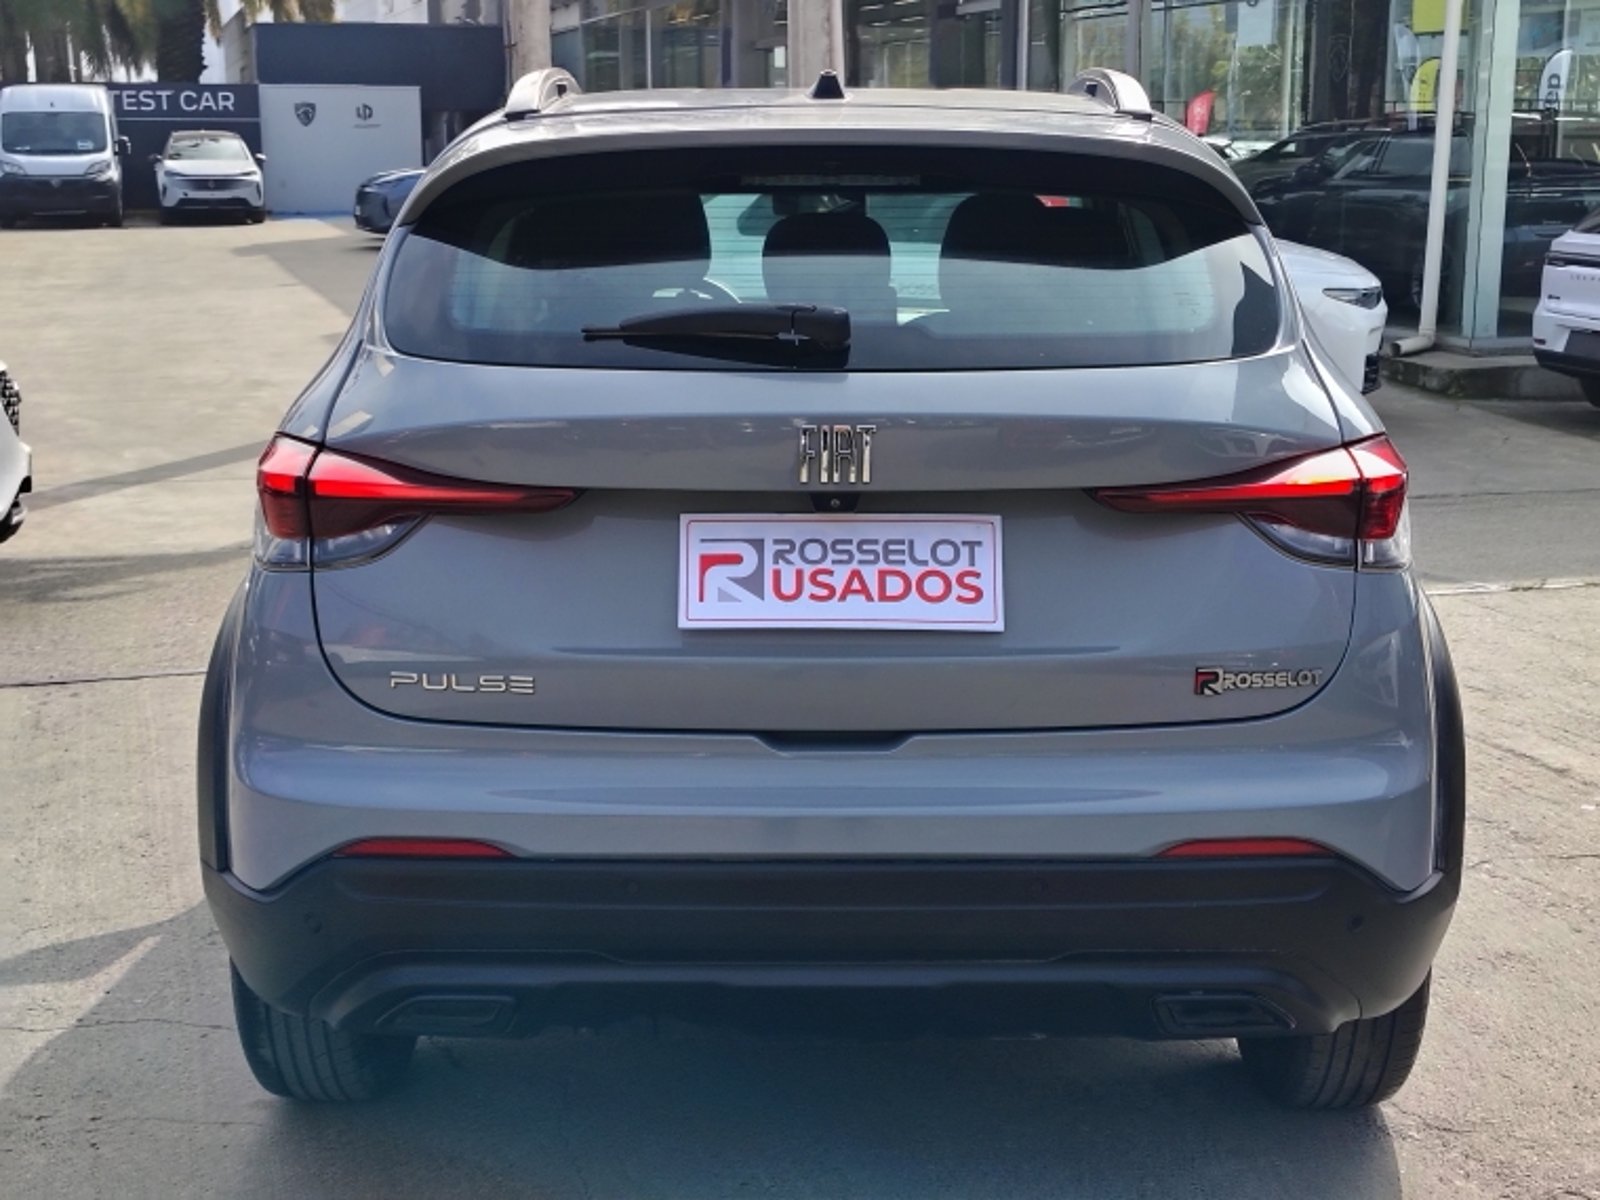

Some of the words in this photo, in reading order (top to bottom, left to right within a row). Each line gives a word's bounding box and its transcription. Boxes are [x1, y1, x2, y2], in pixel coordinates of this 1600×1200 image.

[106, 90, 175, 111] TEST
[180, 90, 235, 111] CAR
[800, 424, 877, 483] FIAT
[772, 538, 983, 567] ROSSELOT
[772, 568, 984, 604] USADOS
[390, 671, 535, 694] PULSE
